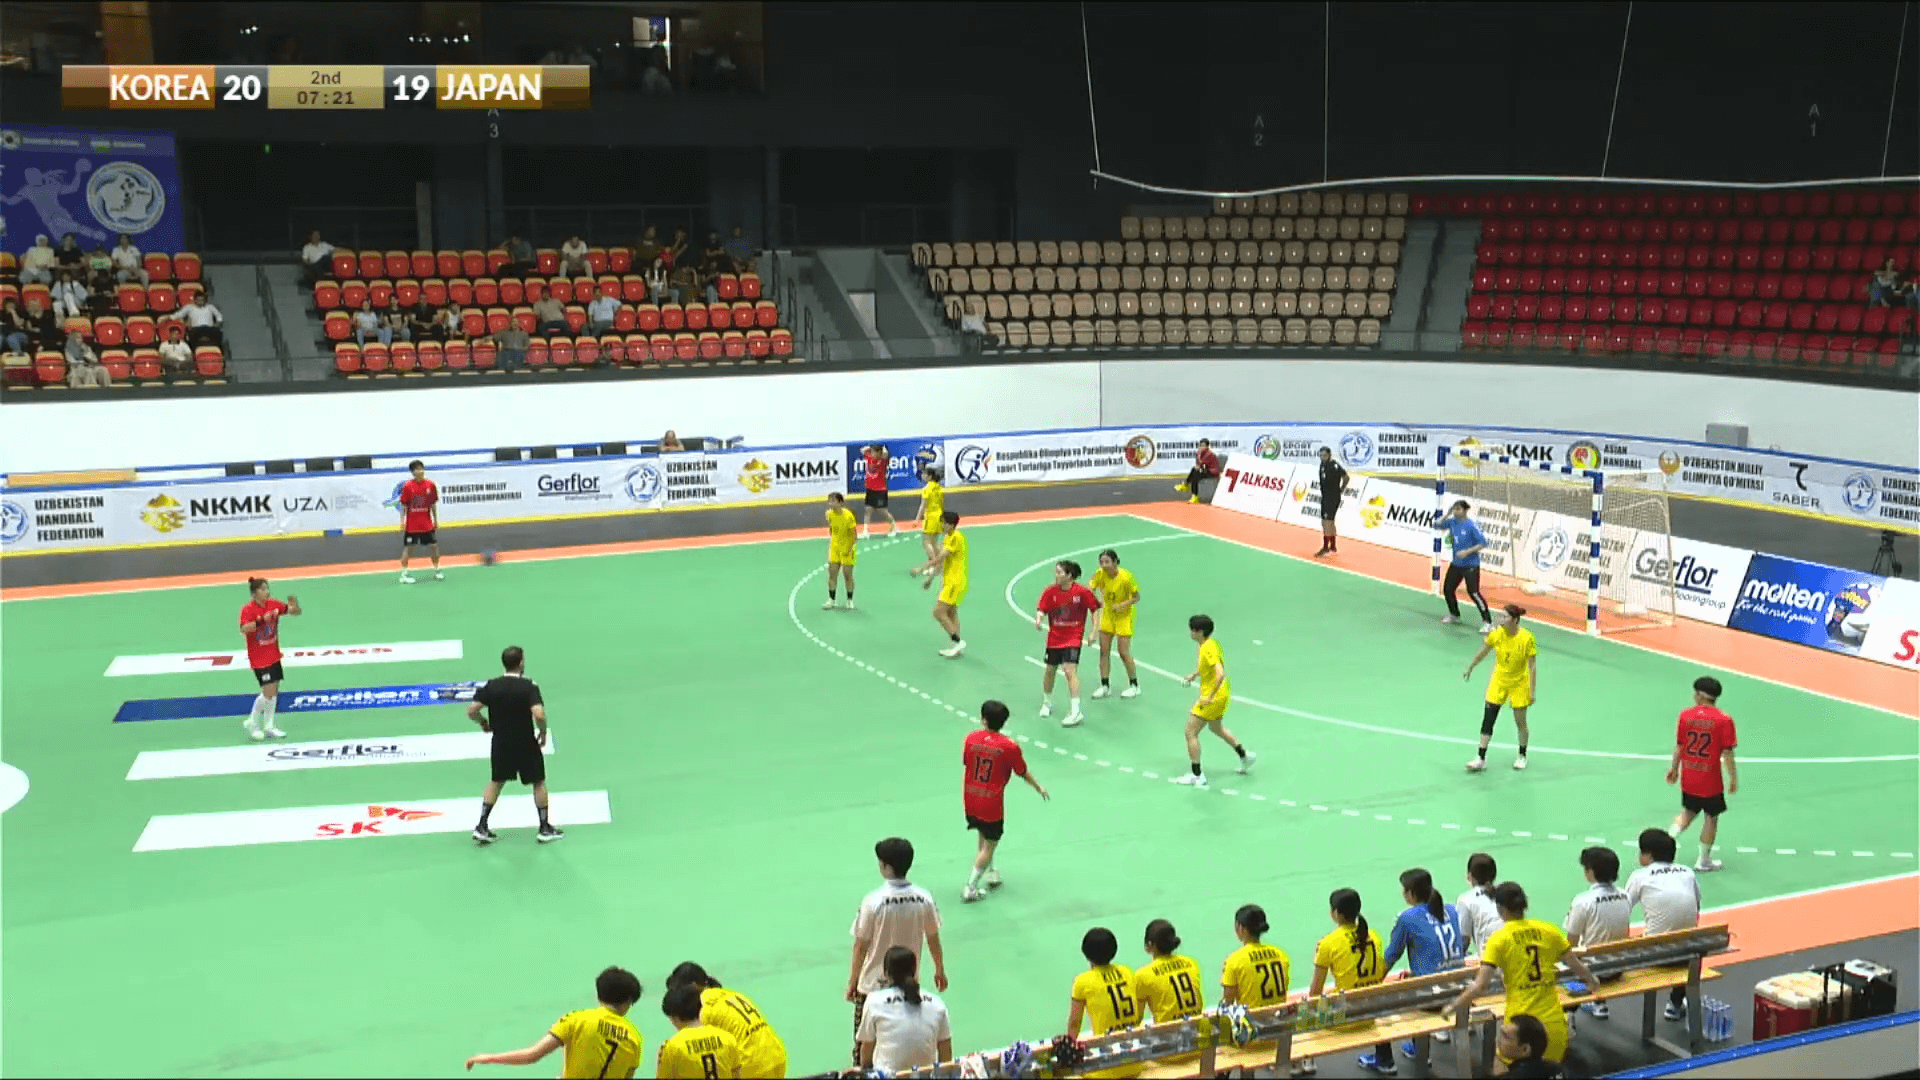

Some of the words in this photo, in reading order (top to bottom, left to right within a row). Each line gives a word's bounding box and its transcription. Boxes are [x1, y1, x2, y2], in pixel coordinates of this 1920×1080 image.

[1808, 104, 1820, 117] A
[489, 123, 500, 138] 3
[1254, 116, 1265, 128] A
[1254, 133, 1264, 146] 2
[1378, 433, 1427, 443] UZBEKISTAN
[1378, 446, 1418, 455] HANDBALL
[1603, 444, 1628, 454] ASIAN
[667, 460, 718, 473] UZBEKISTAN
[775, 460, 839, 479] NKMK
[1378, 458, 1425, 468] FEDERATION
[1603, 456, 1642, 469] HANDBALL
[1737, 461, 1763, 475] MILLIY
[537, 472, 600, 493] Gerflor
[667, 474, 709, 486] HANDBALL
[1240, 472, 1285, 491] ALKASS
[1682, 470, 1721, 485] OLIMPIYA
[667, 487, 717, 500] FEDERATION
[1772, 492, 1820, 509] SABER
[34, 496, 104, 511] UZBEKISTAN
[190, 494, 272, 517] NKMK
[283, 497, 329, 512] UZA
[36, 512, 94, 526] HANDBALL
[1386, 504, 1436, 528] NKMK
[37, 527, 105, 542] FEDERATION
[1635, 548, 1719, 587] Gerflor
[1745, 579, 1825, 612] molten
[1893, 630, 1920, 664] S
[266, 744, 404, 761] Gerflor
[1686, 730, 1712, 758] 22
[974, 756, 993, 783] 13
[314, 819, 386, 838] SK
[1435, 922, 1461, 960] 12
[1525, 945, 1542, 982] 3
[1255, 961, 1286, 999] 20
[1107, 980, 1135, 1019] 15
[1169, 972, 1197, 1010] 19
[600, 1039, 619, 1079] 7
